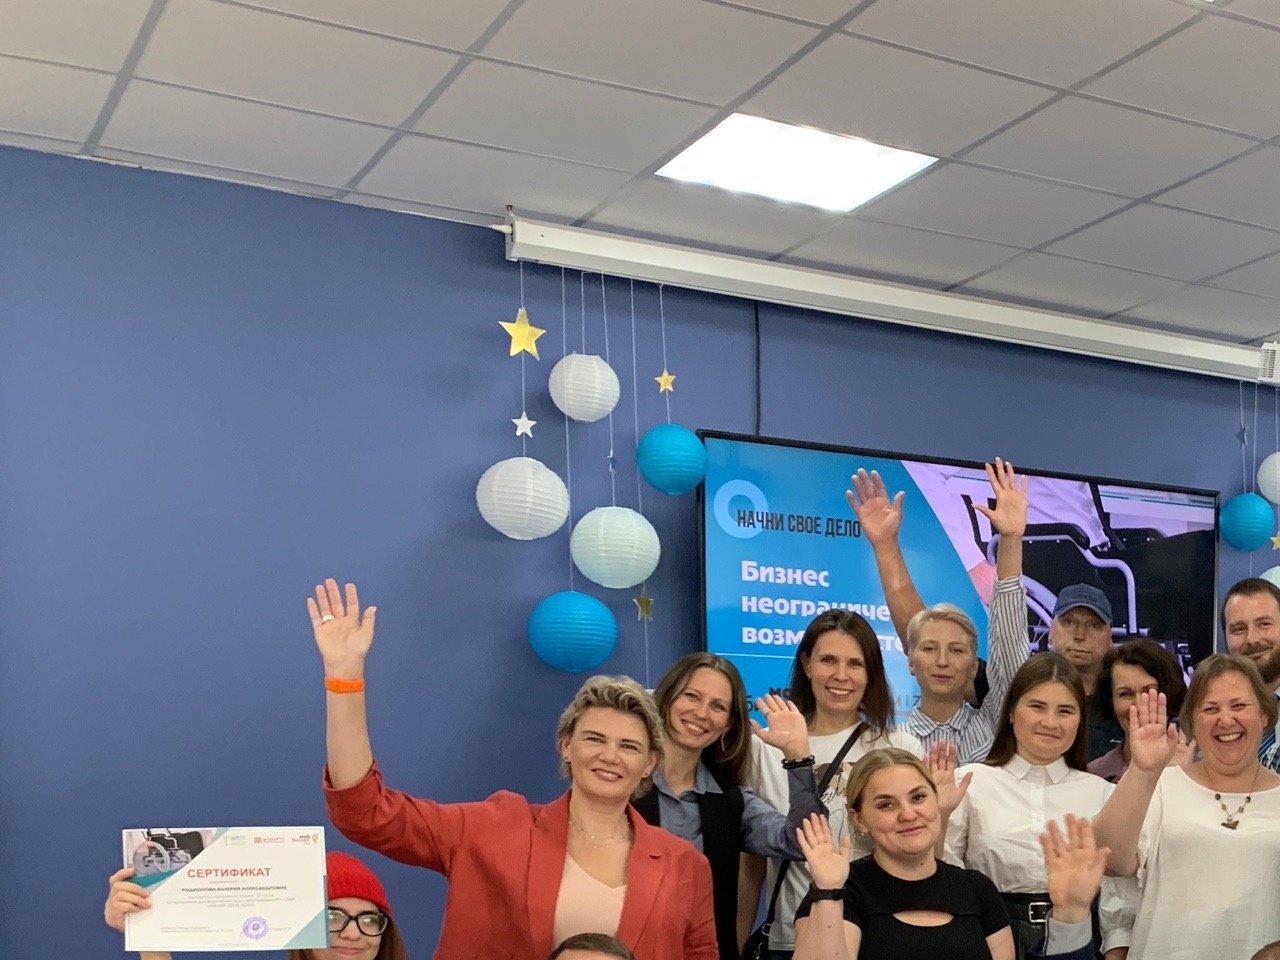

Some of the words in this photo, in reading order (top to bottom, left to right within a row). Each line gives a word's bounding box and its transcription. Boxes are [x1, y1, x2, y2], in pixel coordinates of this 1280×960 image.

[738, 509, 784, 529] НАЧНИ
[788, 514, 821, 534] СВОЕ
[825, 518, 861, 538] ДЕЛО
[742, 560, 829, 587] Бизнес
[187, 867, 272, 879] СЕРТИФИКАТ
